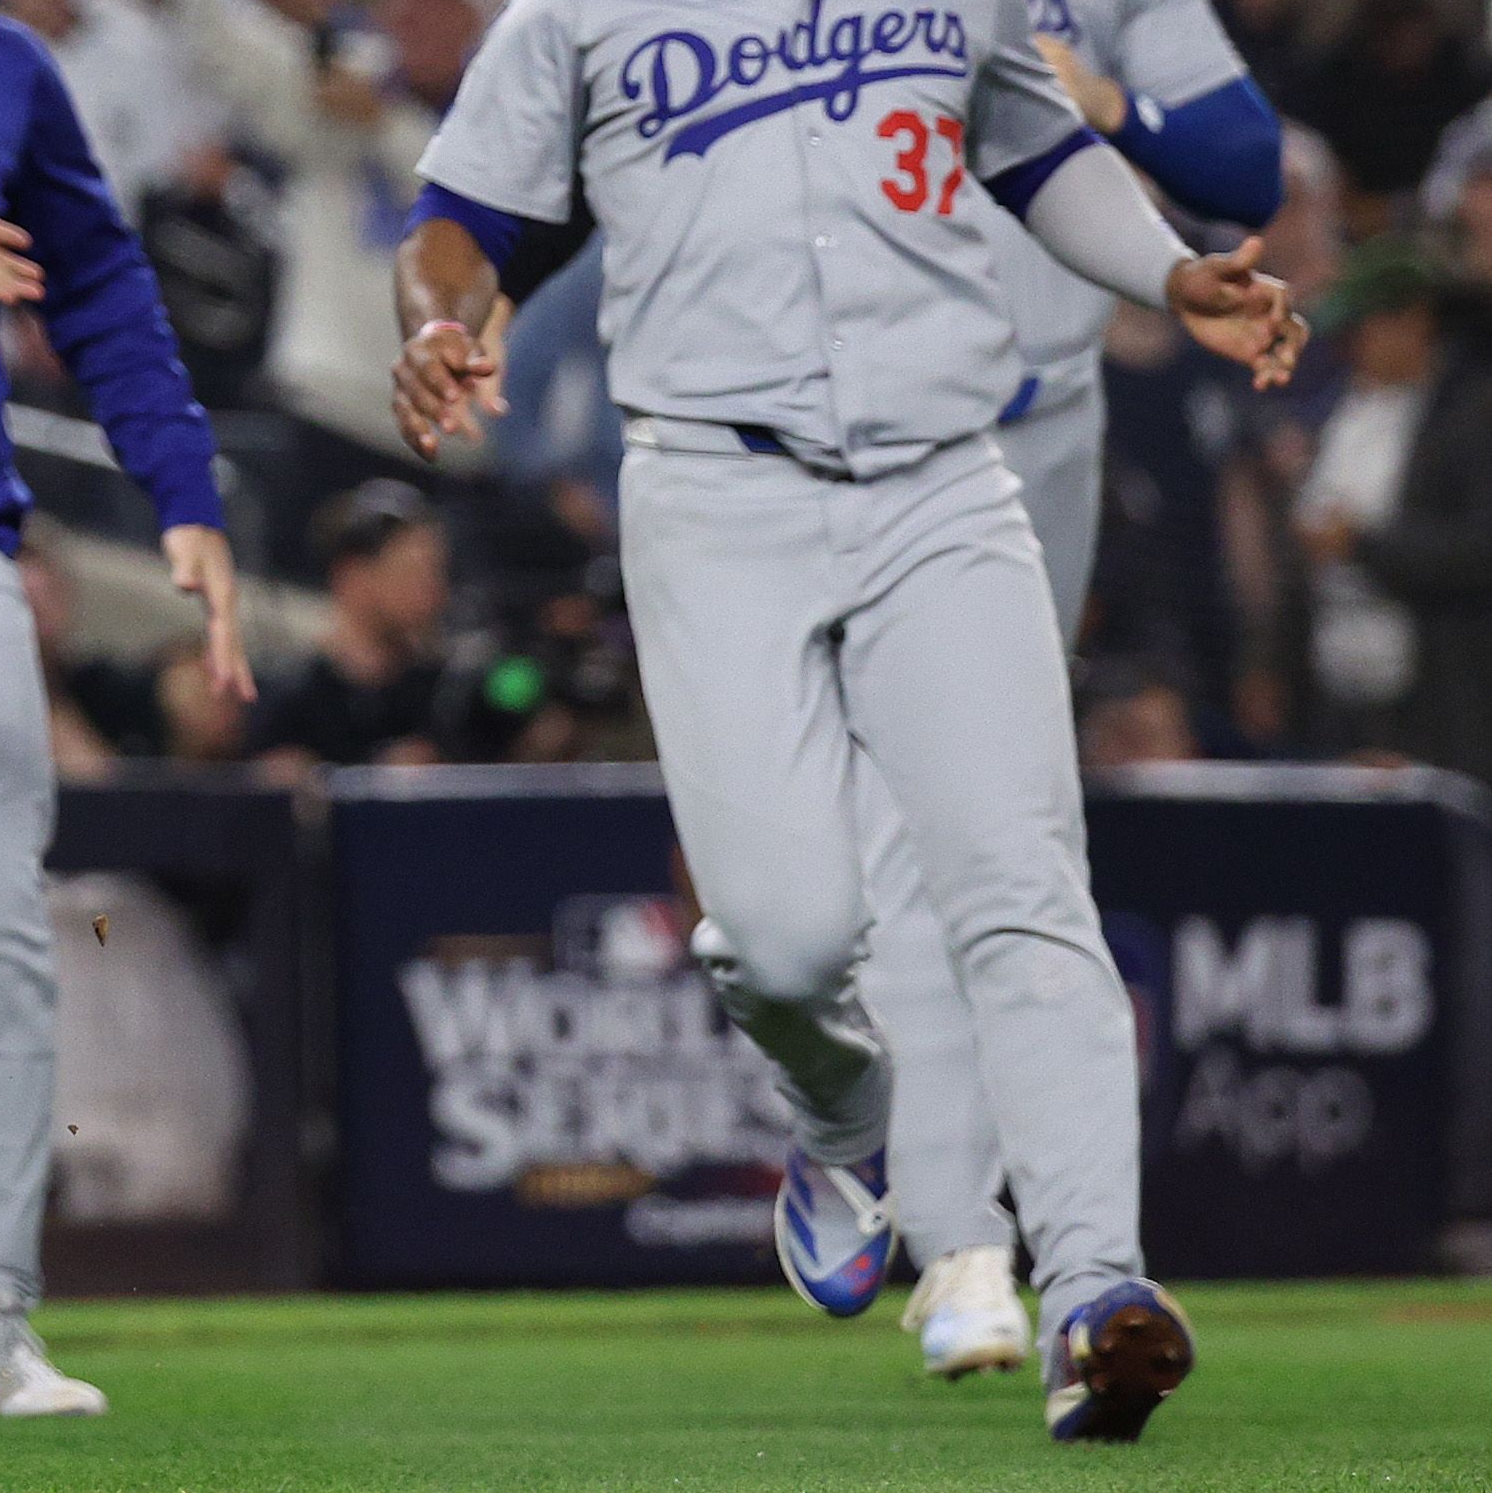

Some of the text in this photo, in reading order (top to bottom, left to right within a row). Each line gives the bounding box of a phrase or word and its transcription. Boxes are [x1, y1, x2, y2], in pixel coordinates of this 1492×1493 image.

[876, 110, 965, 216] 37
[399, 954, 753, 1078] WORL
[1170, 913, 1434, 1054] MLB
